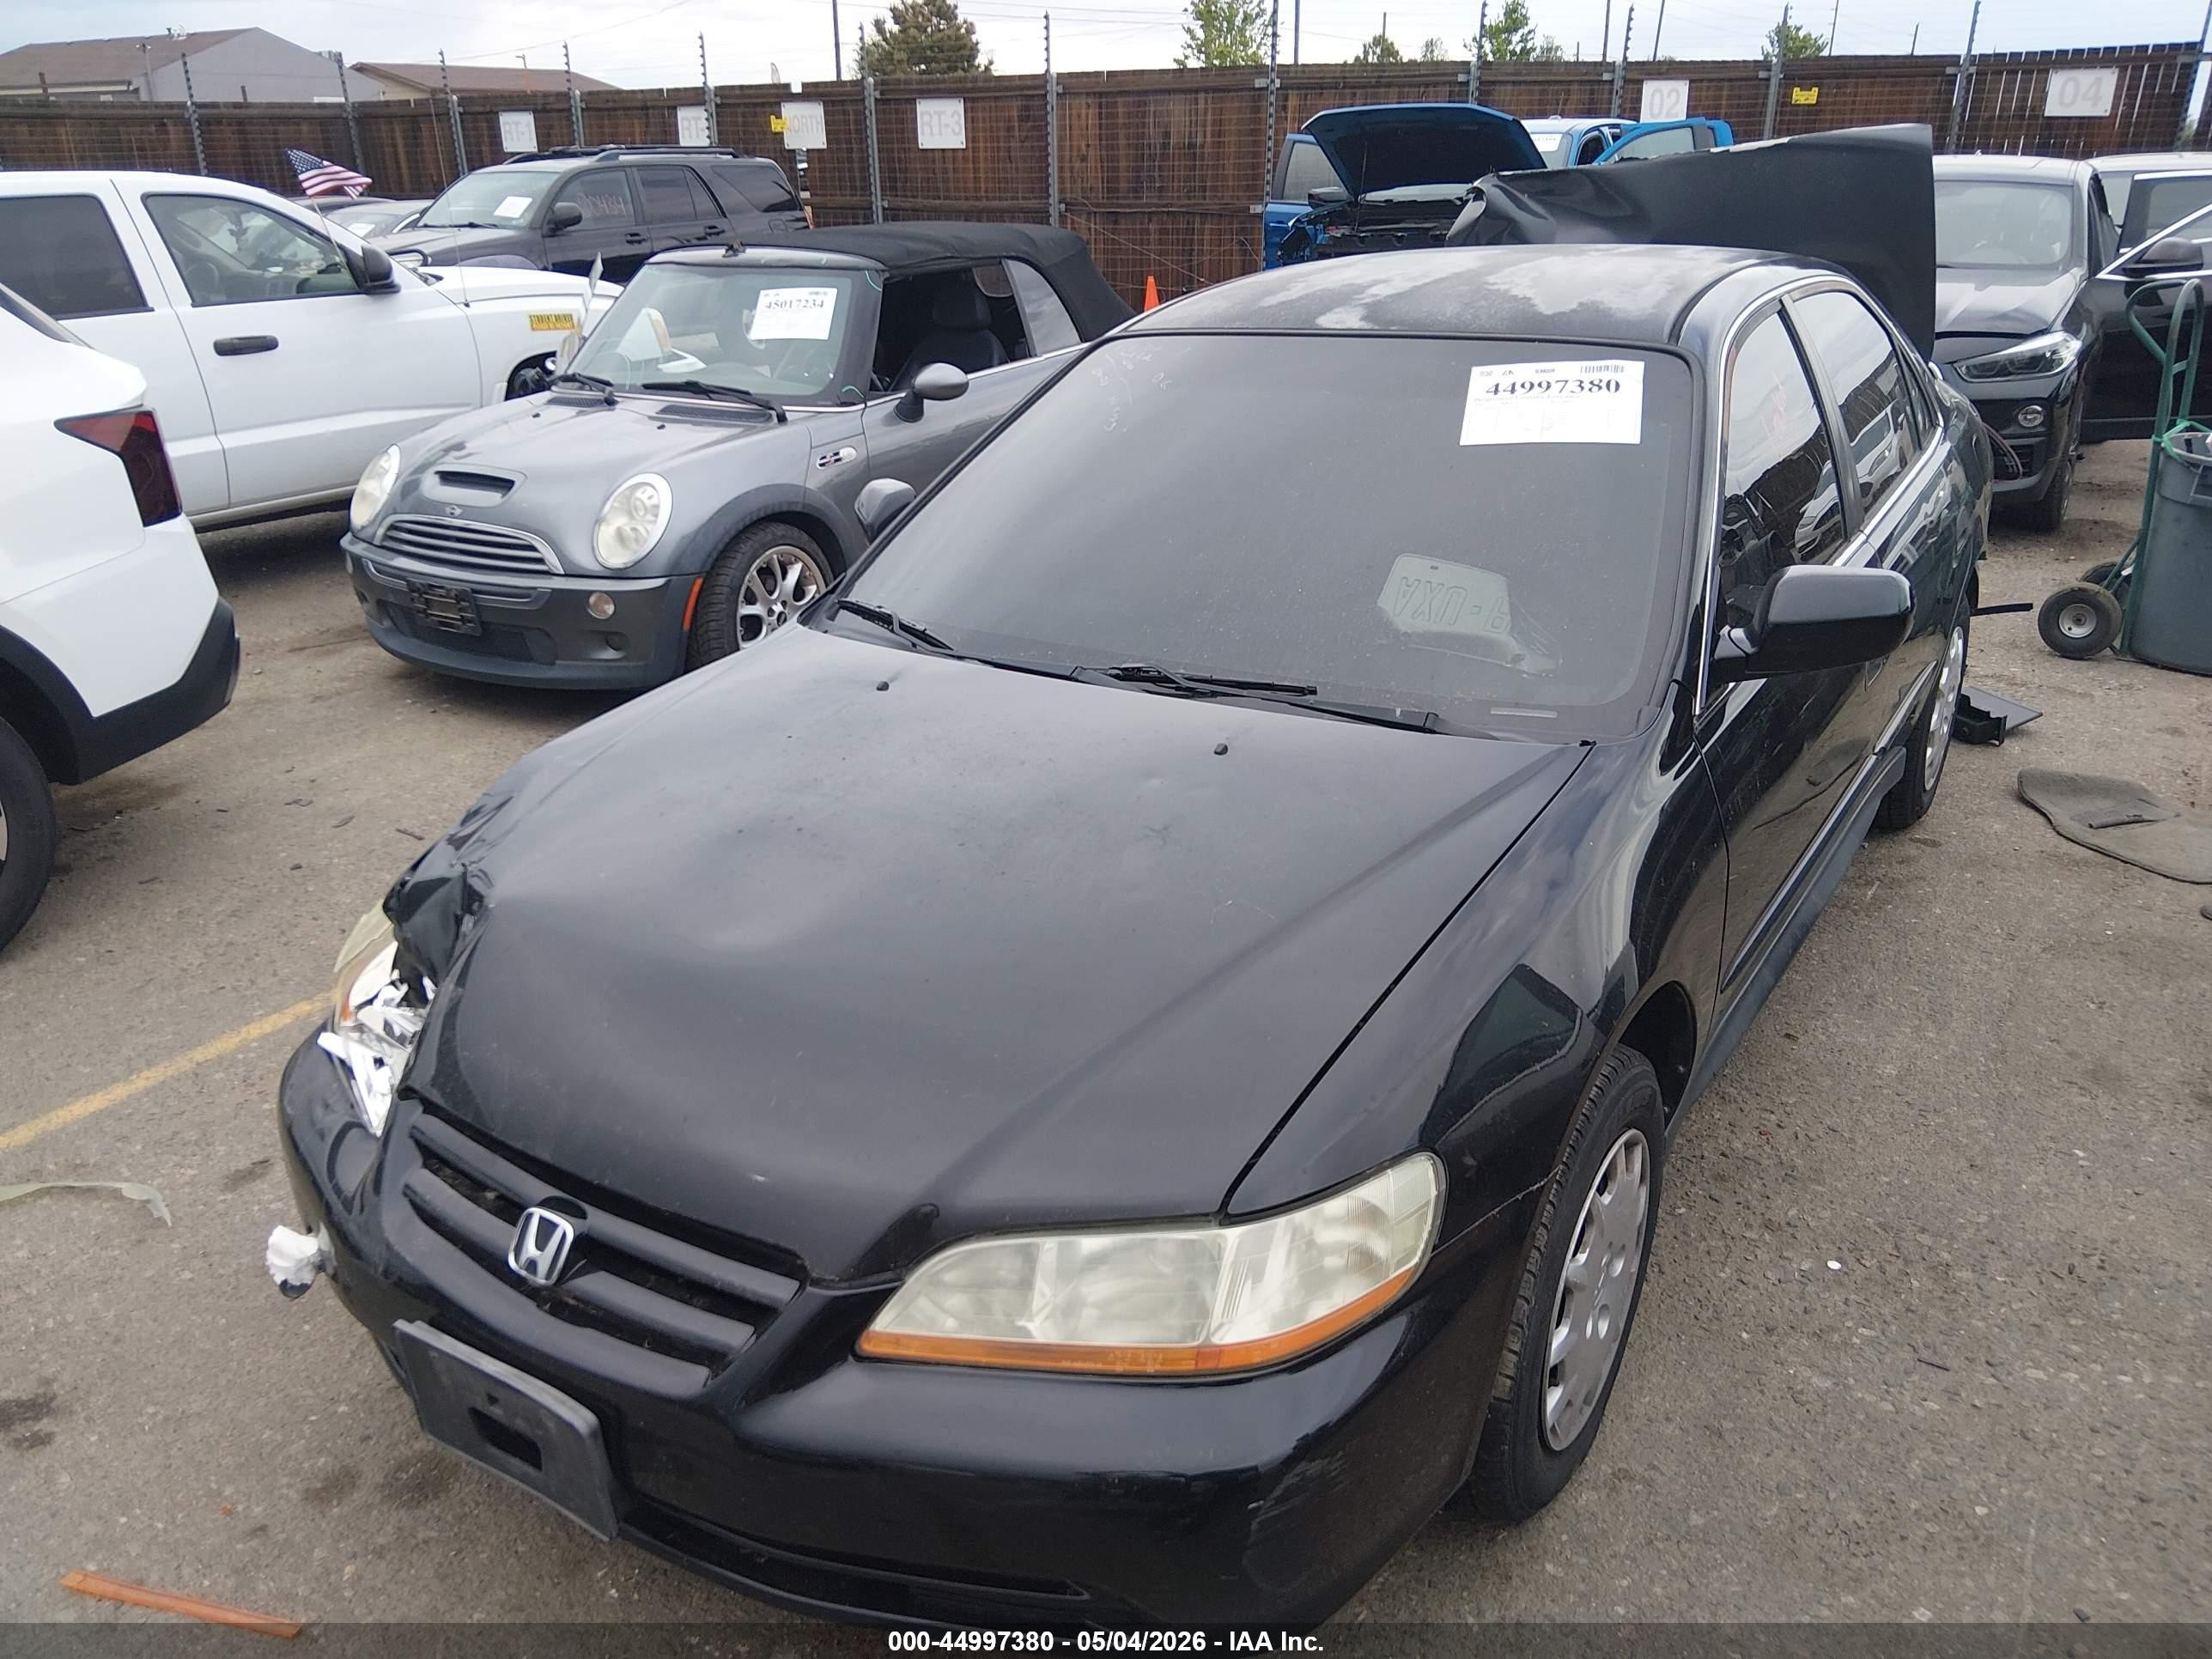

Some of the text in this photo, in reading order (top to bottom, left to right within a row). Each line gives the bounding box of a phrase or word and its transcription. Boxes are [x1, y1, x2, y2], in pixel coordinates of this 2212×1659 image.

[1648, 88, 1681, 120] 02
[2057, 76, 2103, 109] 04
[919, 109, 963, 137] RT-3
[763, 298, 825, 310] 45017234
[1485, 378, 1621, 396] 44997380
